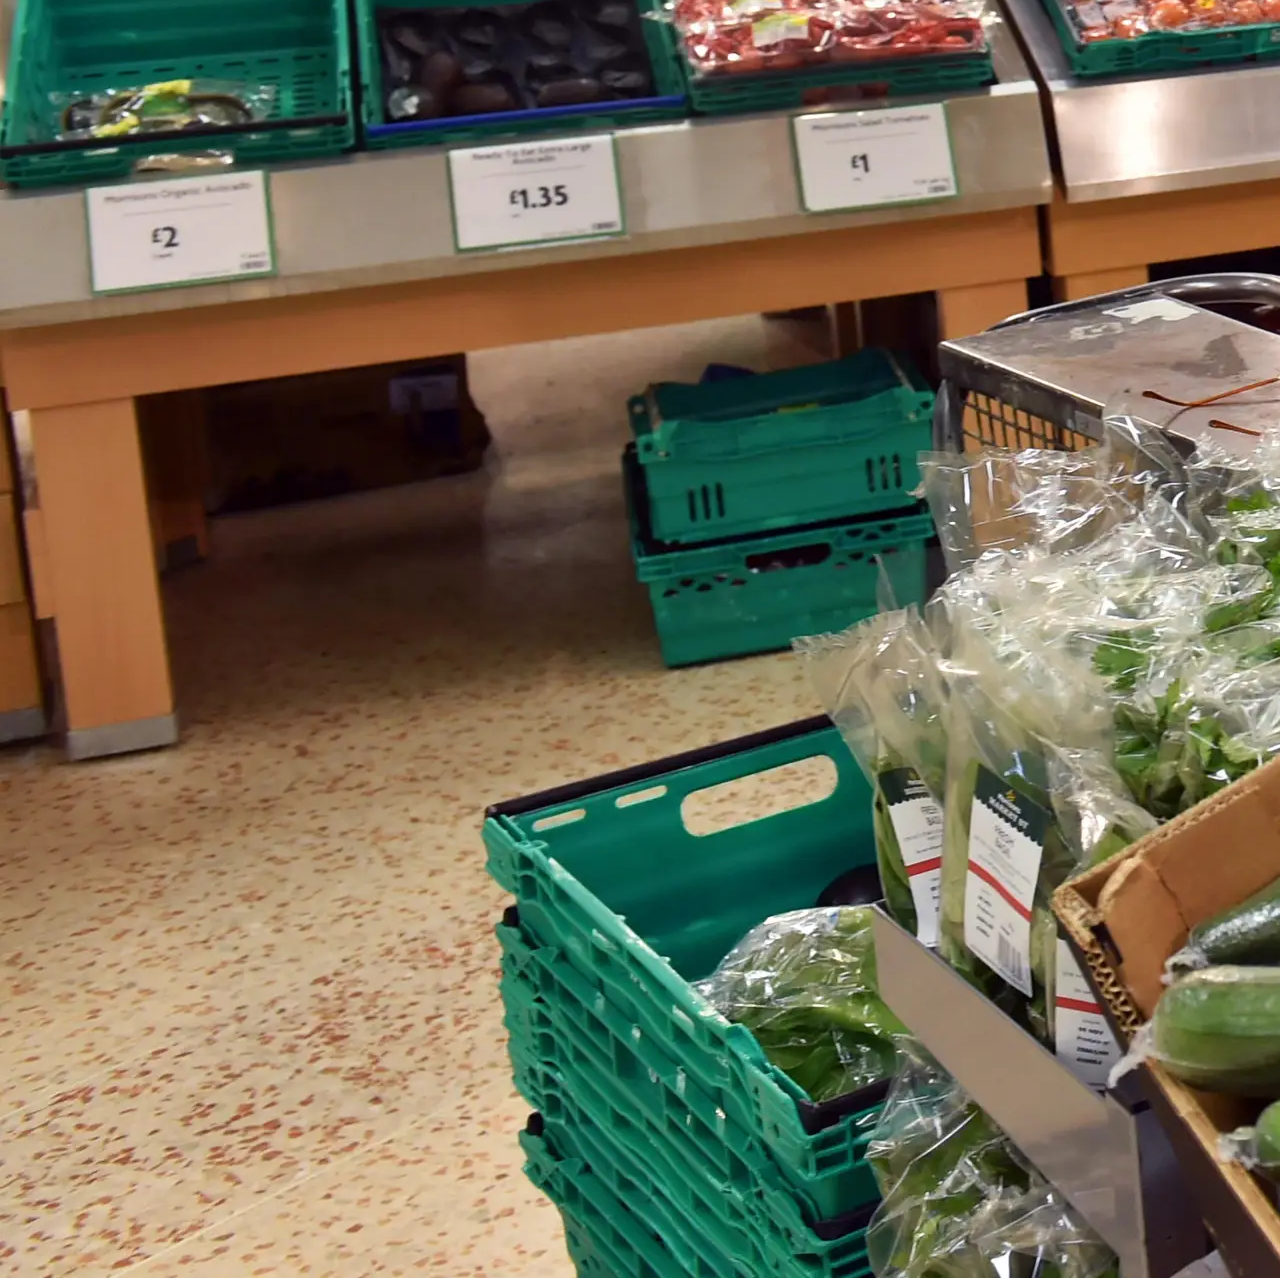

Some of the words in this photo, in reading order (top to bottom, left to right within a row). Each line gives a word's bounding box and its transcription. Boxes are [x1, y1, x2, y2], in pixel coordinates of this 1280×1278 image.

[851, 152, 871, 174] £1
[509, 184, 569, 210] £1.35
[151, 224, 179, 249] £2
